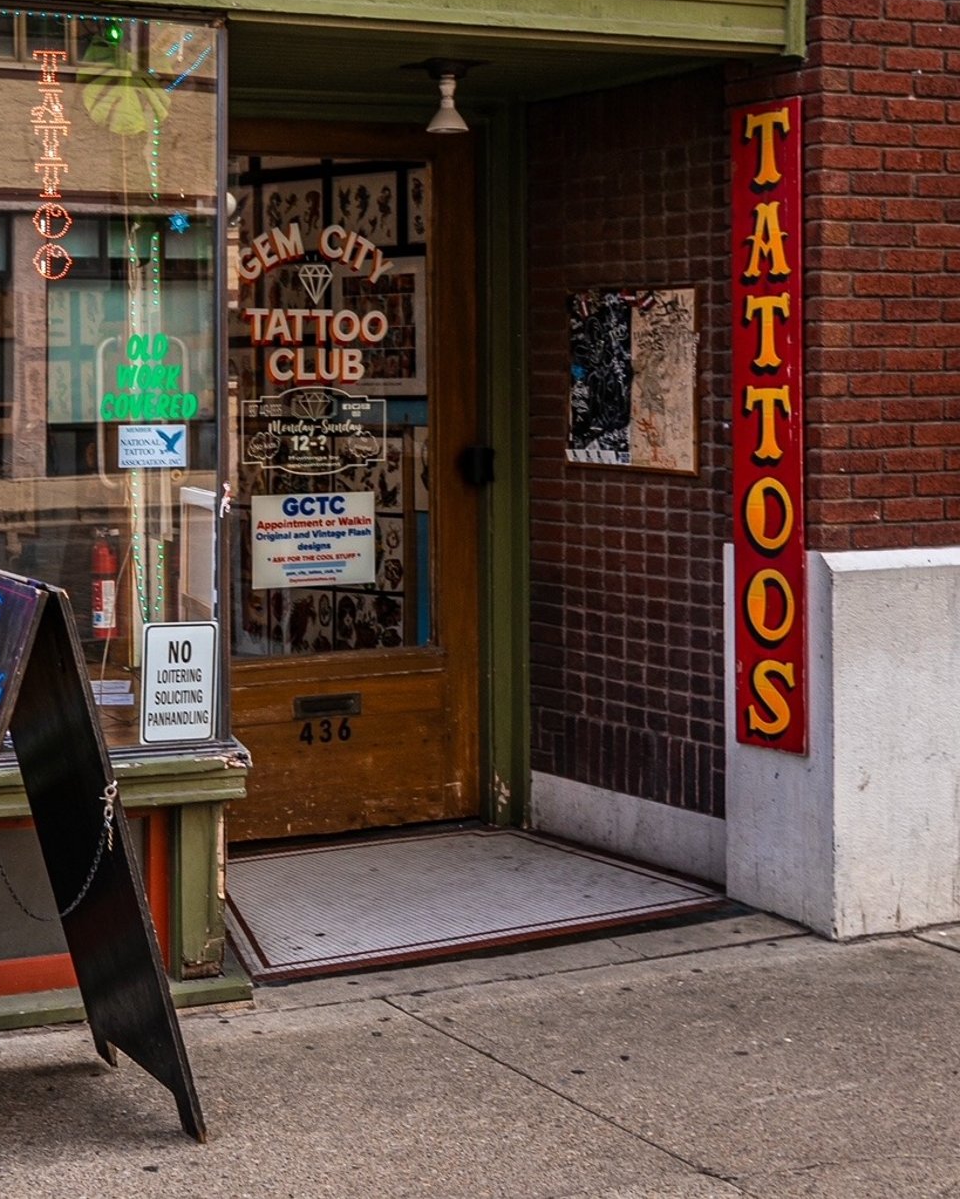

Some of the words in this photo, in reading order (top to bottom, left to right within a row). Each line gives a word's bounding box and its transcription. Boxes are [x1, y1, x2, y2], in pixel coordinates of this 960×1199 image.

[31, 50, 73, 280] TATTOO
[238, 222, 305, 283] GEM
[320, 224, 395, 285] CITY
[244, 307, 389, 345] TATTOO
[127, 332, 169, 361] OLD
[266, 348, 365, 384] CLUB
[116, 364, 183, 390] WORK
[100, 392, 198, 421] COVERED
[745, 105, 795, 736] TATTOOS
[120, 439, 161, 447] NATIONAL
[124, 448, 156, 456] TATTOO
[291, 434, 327, 451] 12-?
[282, 495, 346, 516] GCTC
[256, 519, 323, 531] Appointment
[338, 516, 372, 526] Walkin
[256, 531, 292, 542] Original
[293, 531, 310, 539] and
[312, 529, 346, 540] Vintage
[348, 527, 372, 537] Flash
[297, 542, 331, 552] designs
[335, 552, 356, 560] STUFF
[168, 640, 192, 663] NO
[157, 668, 202, 684] LOITERING
[154, 689, 203, 706] SOLICITING
[147, 710, 209, 727] PANHANDLING
[298, 717, 352, 746] 436
